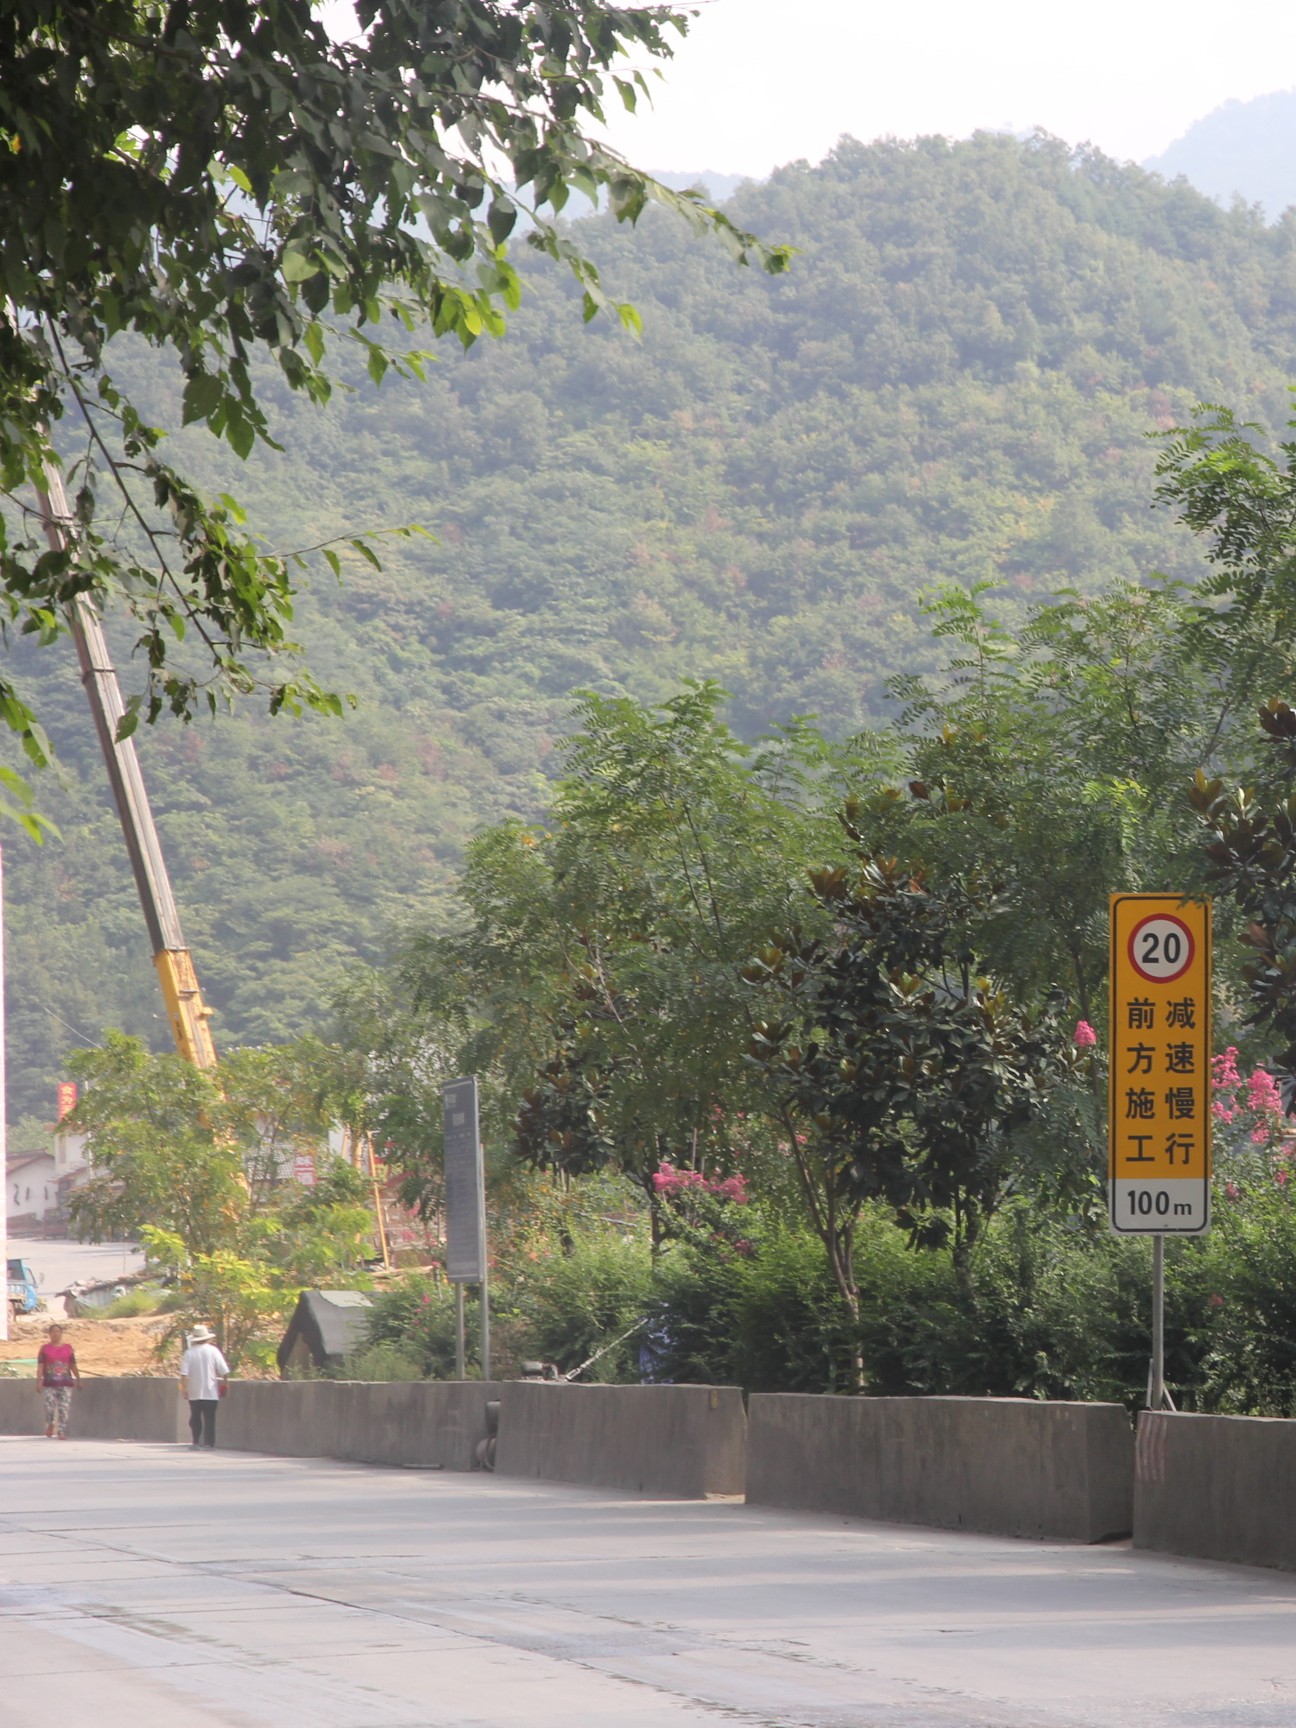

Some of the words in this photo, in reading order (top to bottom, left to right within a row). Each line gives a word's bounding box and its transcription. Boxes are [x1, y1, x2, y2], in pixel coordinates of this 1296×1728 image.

[1141, 932, 1181, 964] 20
[1125, 997, 1156, 1163] 前方施工
[1165, 997, 1196, 1165] 减速慢行
[1127, 1190, 1193, 1216] 100m
